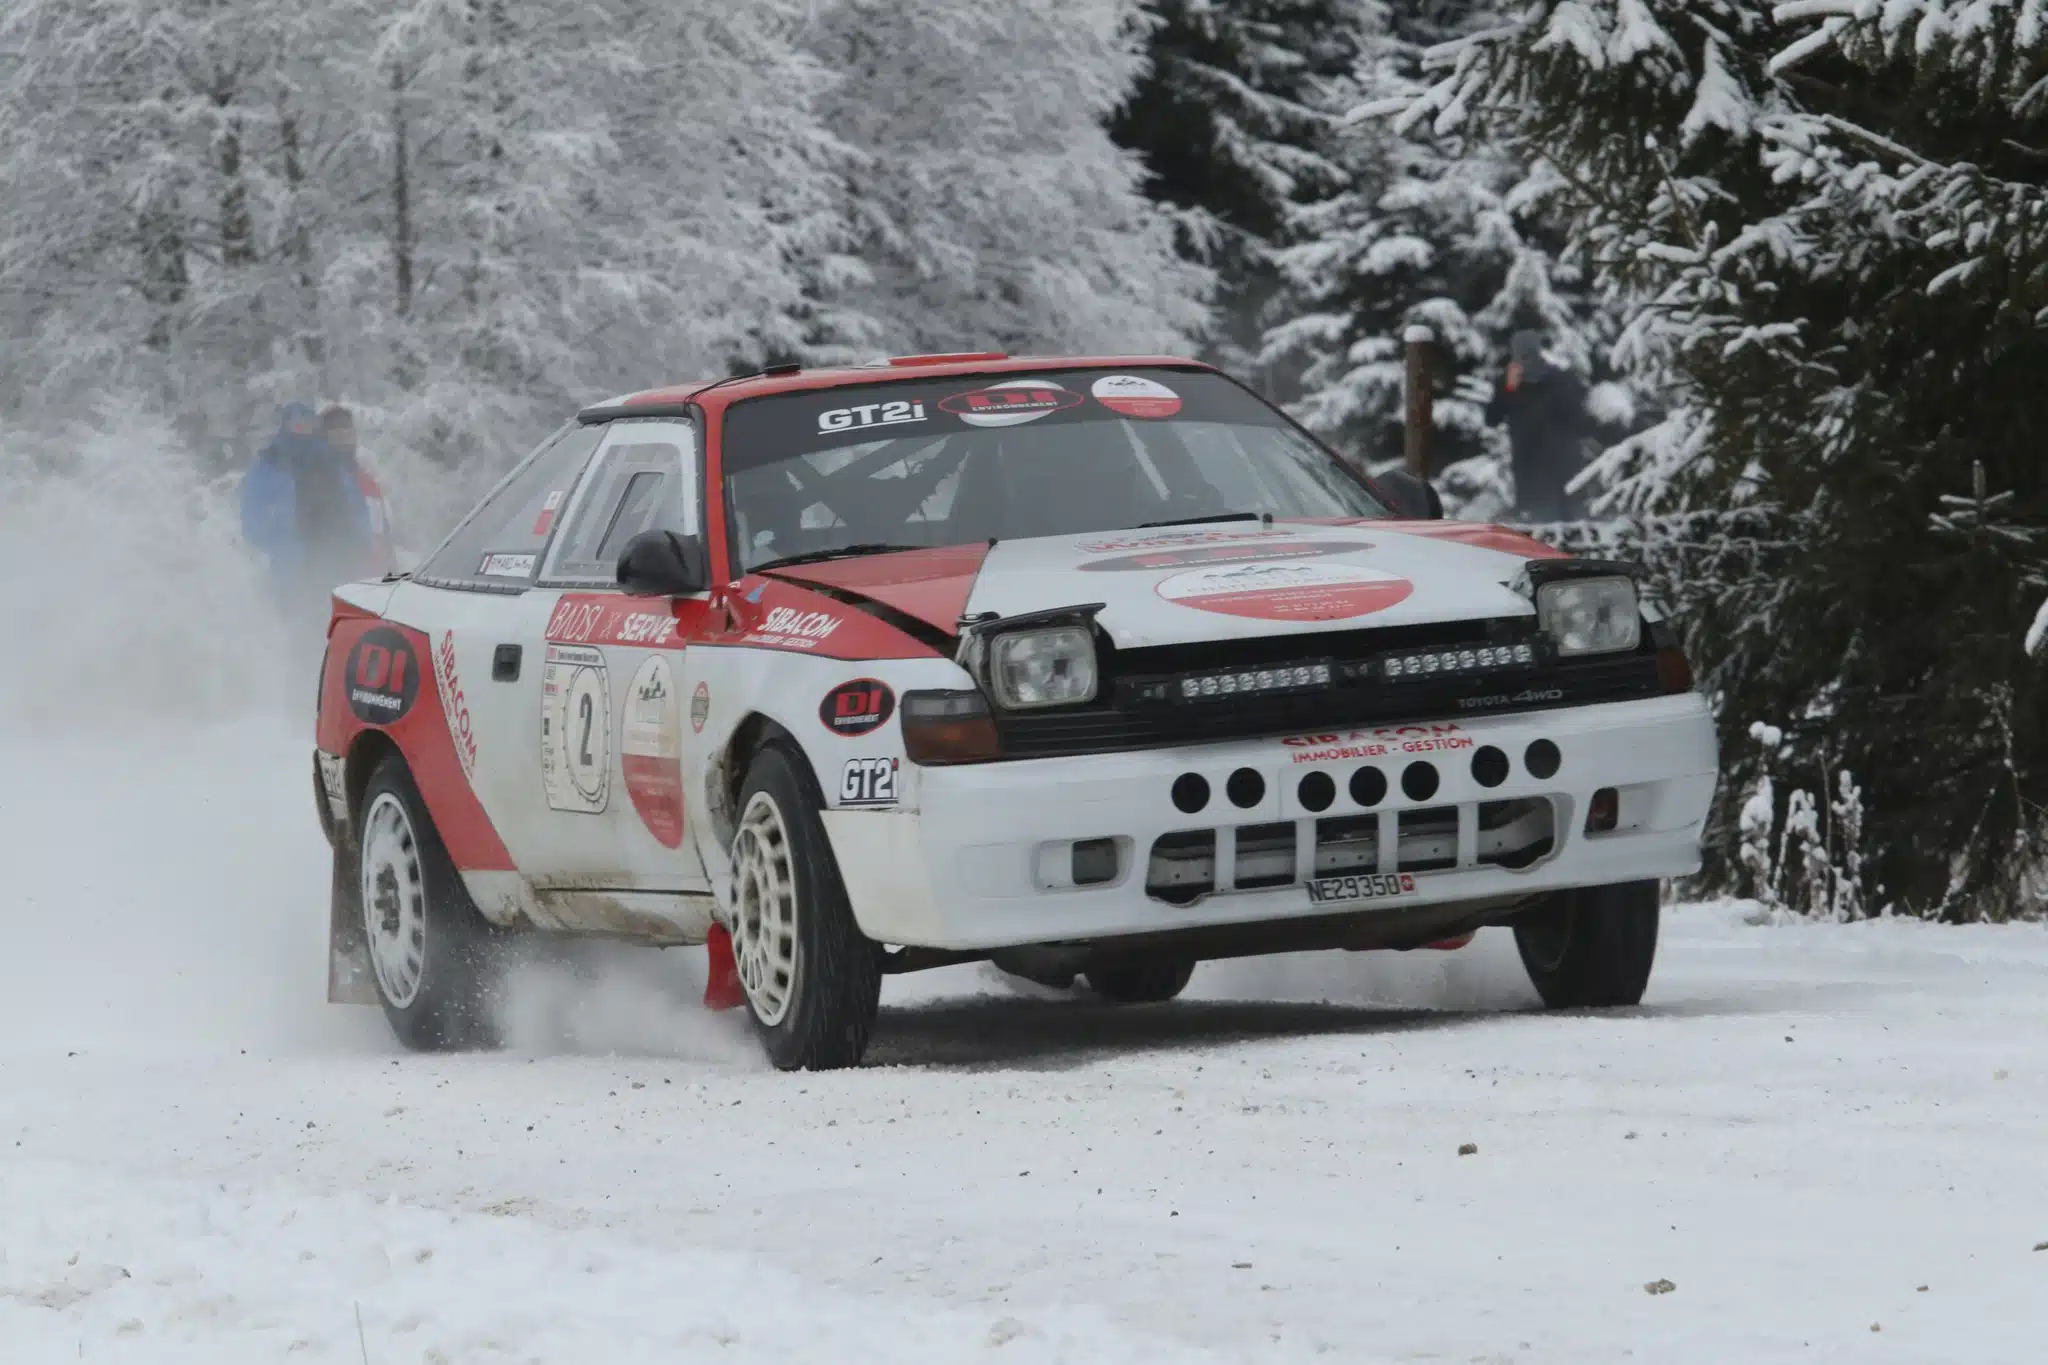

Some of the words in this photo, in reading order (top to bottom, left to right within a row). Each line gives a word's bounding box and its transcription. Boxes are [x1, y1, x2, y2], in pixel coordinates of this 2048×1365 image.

[818, 399, 925, 430] GT2i
[758, 607, 843, 638] SIBACOM
[355, 643, 408, 693] DI
[440, 629, 478, 767] SIBACOM
[837, 688, 882, 716] DI
[1459, 694, 1510, 709] TOYOTA
[1511, 688, 1563, 702] 4WD
[579, 692, 593, 767] 2
[1291, 744, 1389, 764] IMMOBILIER
[1402, 735, 1474, 753] GESTION
[841, 758, 898, 801] GT2i
[1306, 873, 1401, 902] NE29350
